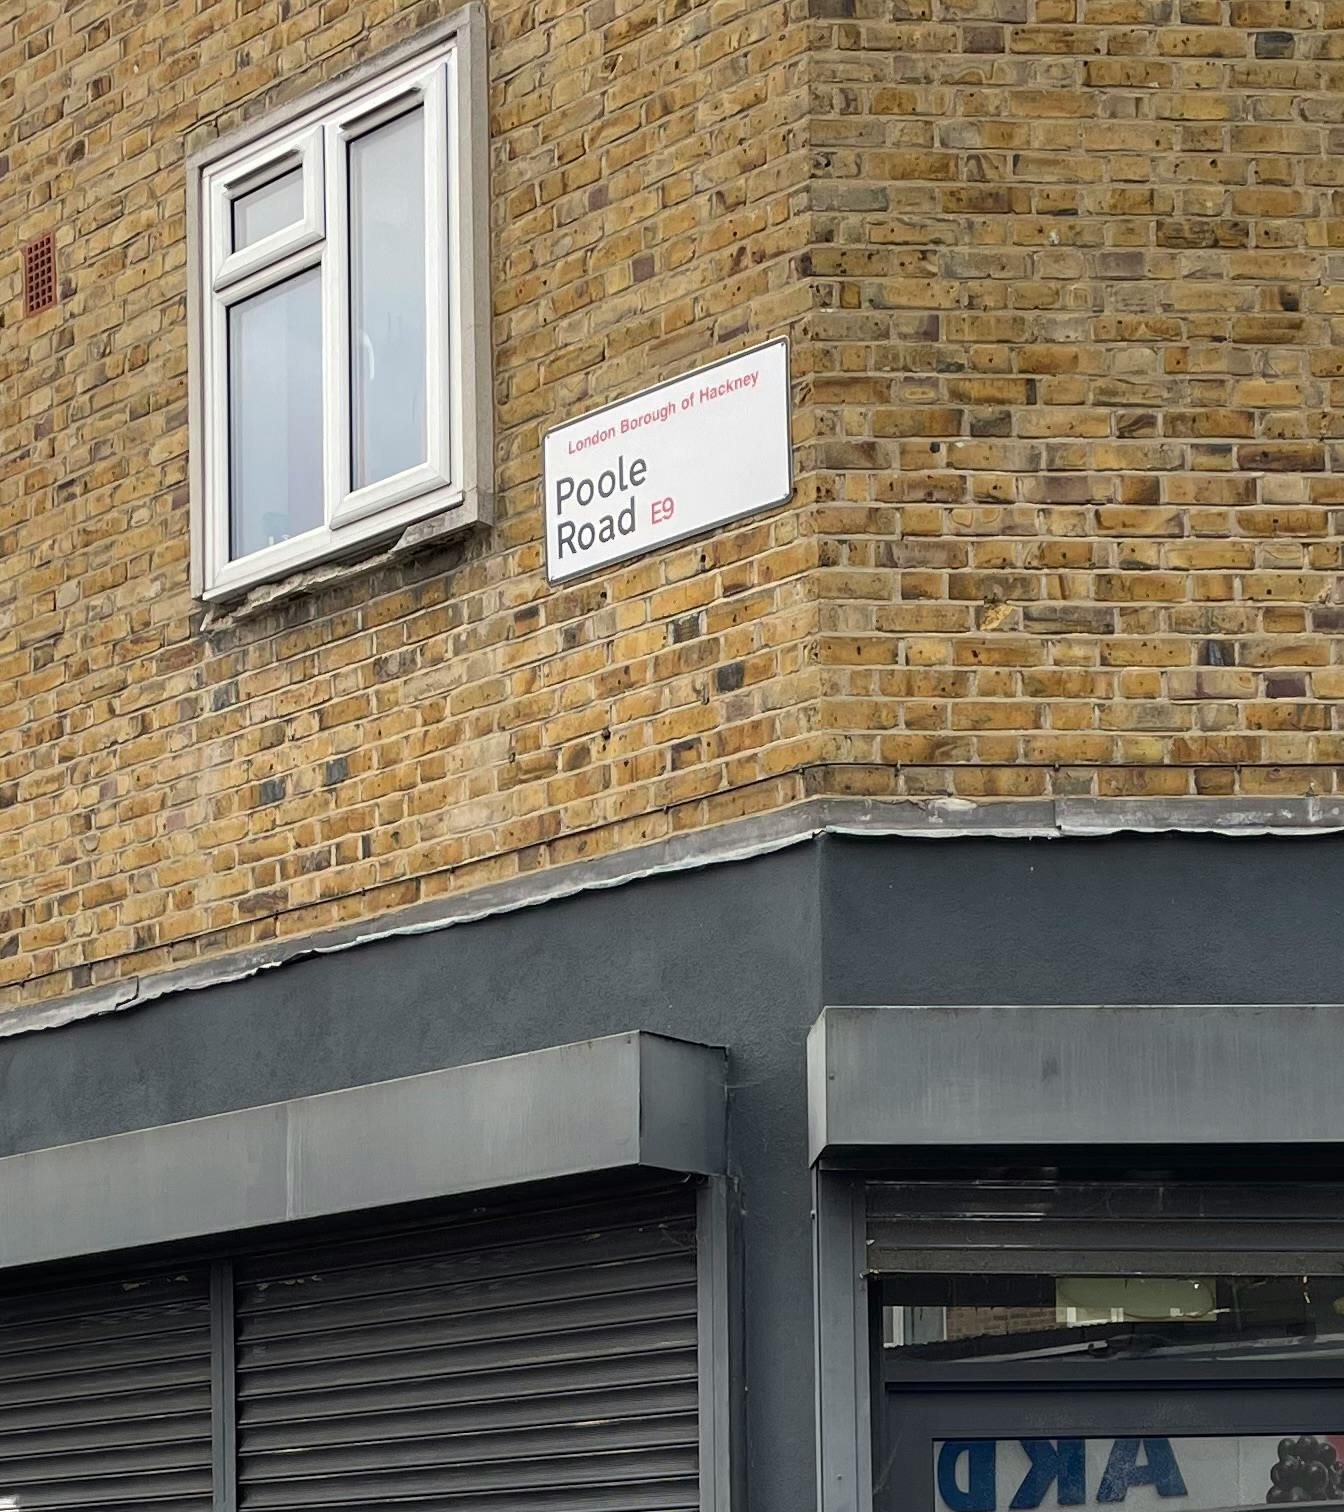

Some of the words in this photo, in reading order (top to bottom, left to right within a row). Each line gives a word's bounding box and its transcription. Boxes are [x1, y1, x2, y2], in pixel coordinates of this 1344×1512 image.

[567, 426, 616, 455] London
[620, 402, 676, 434] Borough
[681, 392, 694, 411] of
[699, 371, 759, 404] Hackney
[556, 455, 647, 516] Poole
[557, 496, 636, 559] Road
[651, 497, 675, 525] E9
